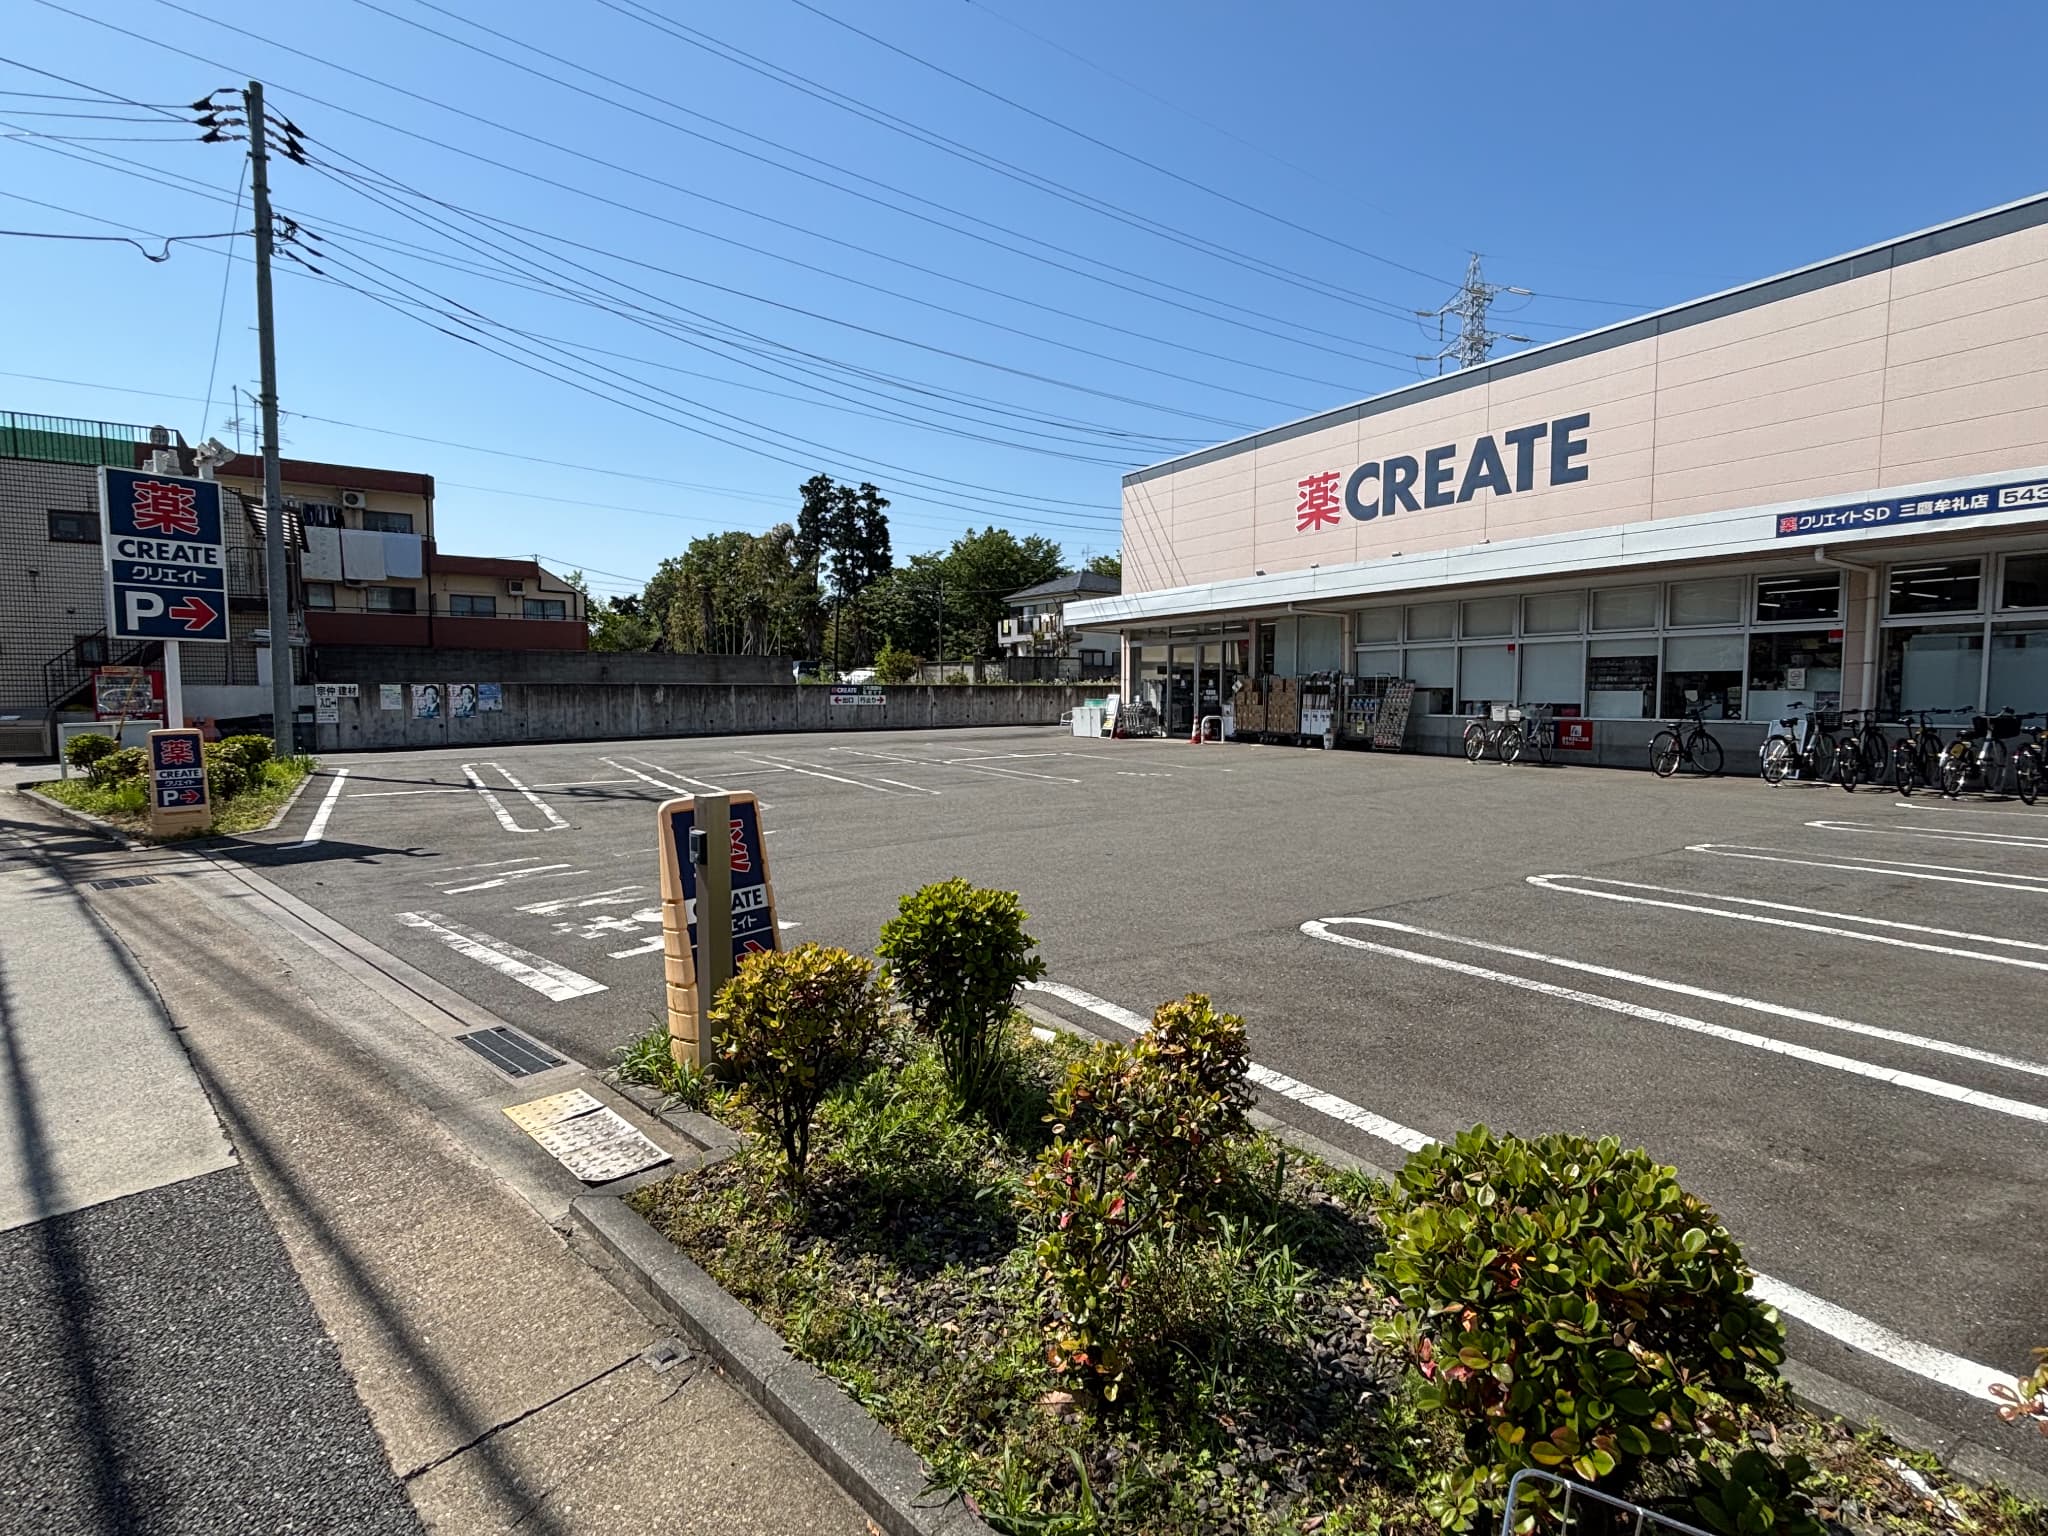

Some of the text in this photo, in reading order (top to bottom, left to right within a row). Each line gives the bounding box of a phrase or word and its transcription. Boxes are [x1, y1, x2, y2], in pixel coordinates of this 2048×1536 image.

[1296, 412, 1590, 532] 薬 CREATE
[132, 481, 200, 535] 薬
[1899, 494, 1989, 518] 三鷹牟礼店
[118, 539, 218, 565] CREATE
[132, 566, 207, 584] クリエイト
[125, 591, 164, 630] P
[161, 739, 194, 764] 薬
[160, 769, 199, 779] CREATE
[163, 790, 179, 806] P
